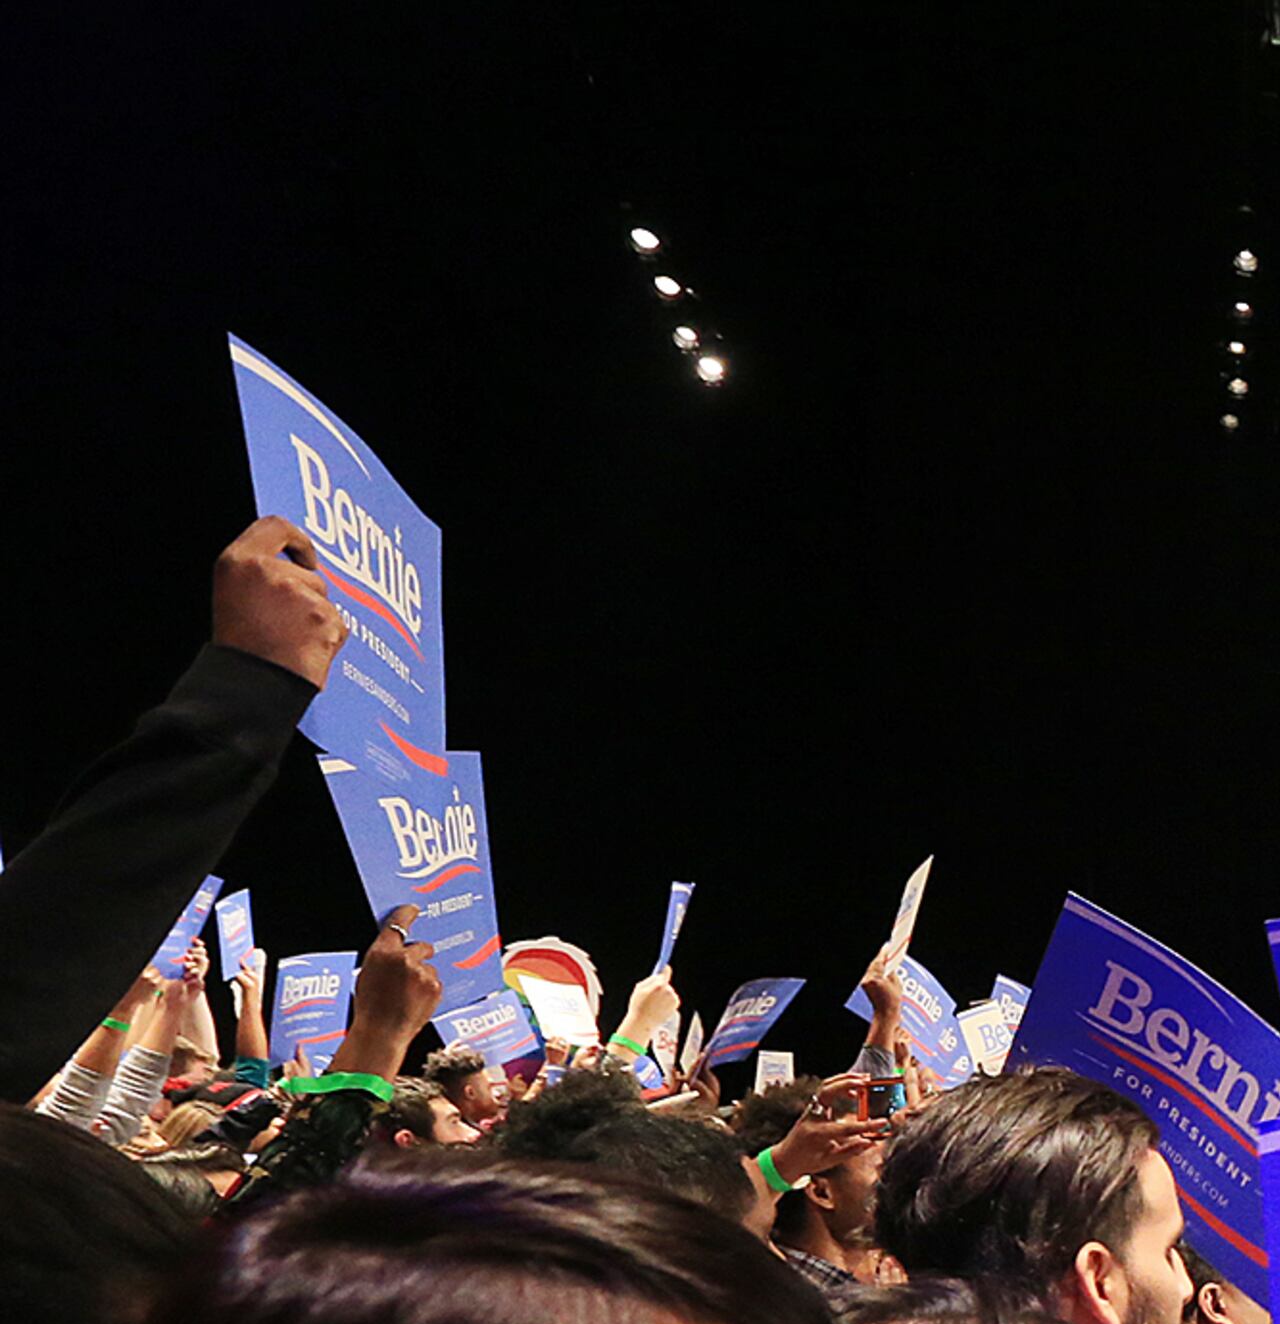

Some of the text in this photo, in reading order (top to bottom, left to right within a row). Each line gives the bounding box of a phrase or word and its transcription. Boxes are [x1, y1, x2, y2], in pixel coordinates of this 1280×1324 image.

[289, 432, 422, 636] Bernie
[378, 785, 478, 869] Bernie
[281, 967, 341, 1005] Bernie
[451, 1003, 517, 1038] Bernie
[1112, 1066, 1253, 1189] FOR PRESIDENT
[1159, 1139, 1231, 1209] ANDERS.COM
